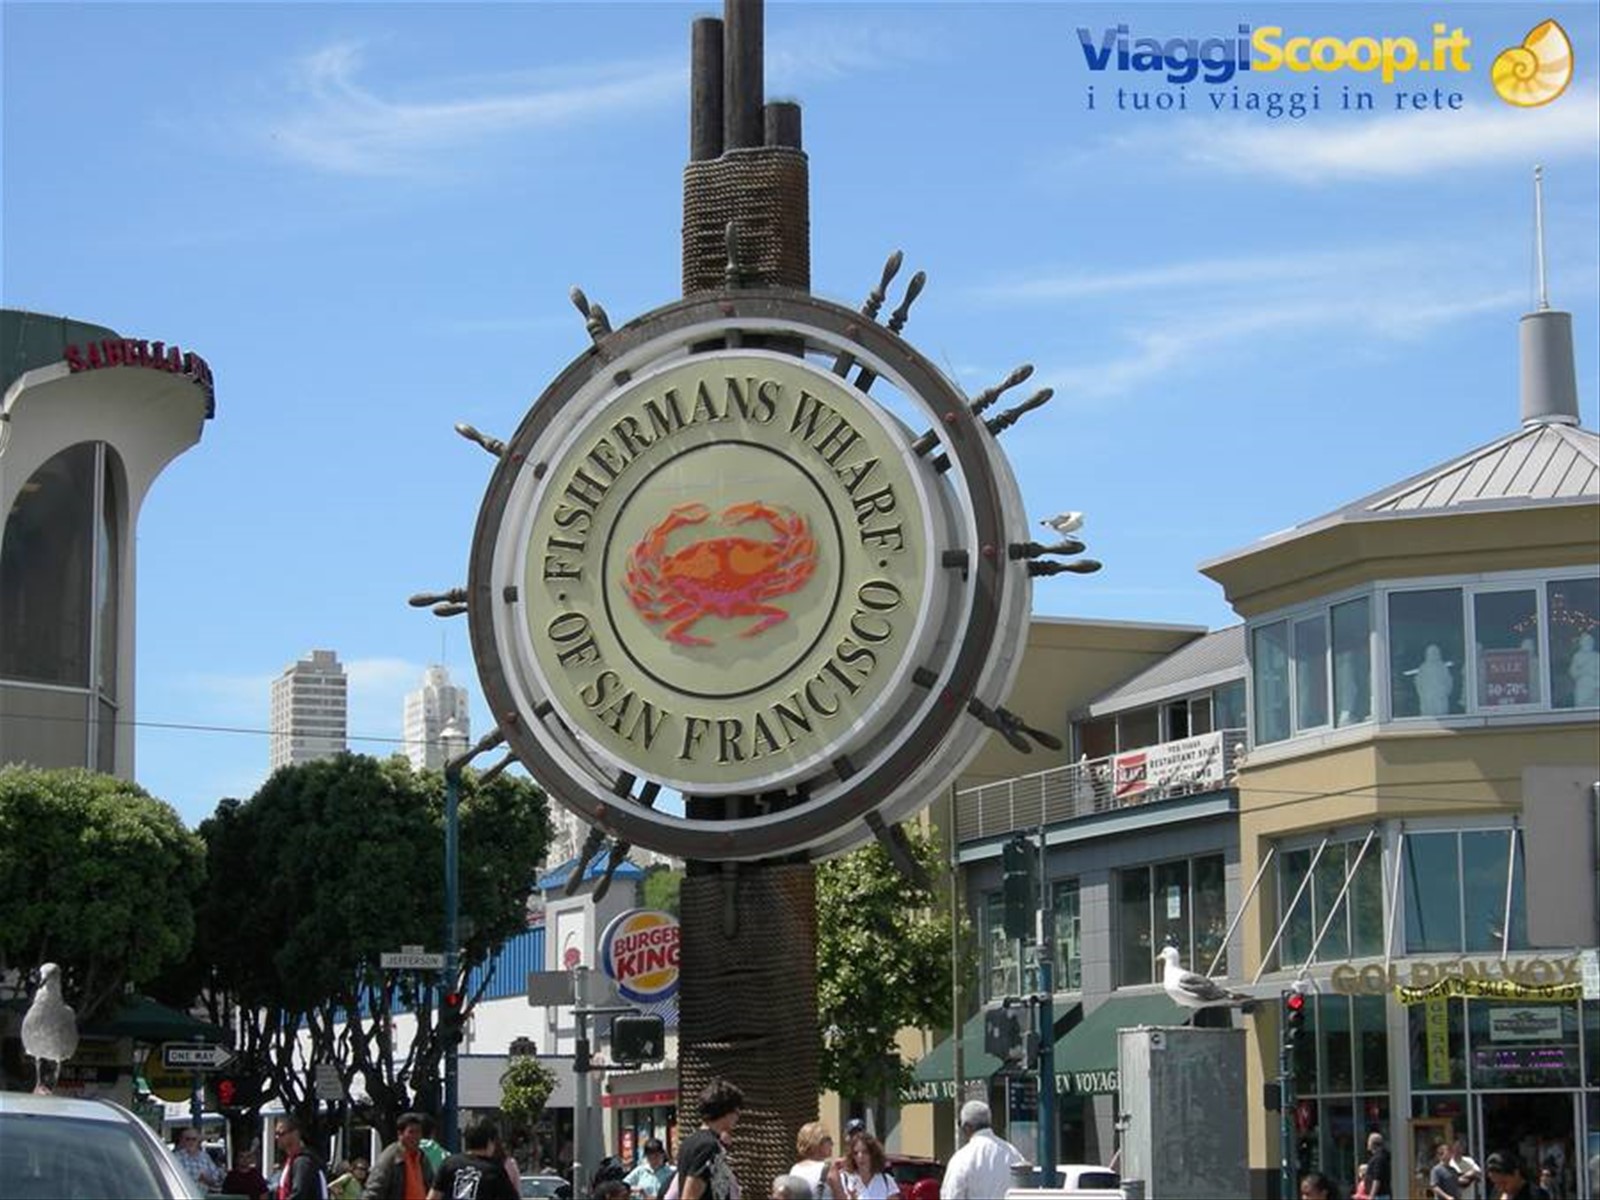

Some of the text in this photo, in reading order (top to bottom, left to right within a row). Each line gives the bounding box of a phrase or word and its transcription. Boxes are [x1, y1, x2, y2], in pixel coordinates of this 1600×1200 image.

[543, 376, 904, 583] FISHERMANS WHARF
[546, 579, 903, 765] OF SAN FRANCISCO
[614, 926, 681, 982] BURGER KING
[1400, 977, 1472, 1004] STOREWDE
[1476, 981, 1509, 997] SALE
[171, 1051, 214, 1061] ONE WAY
